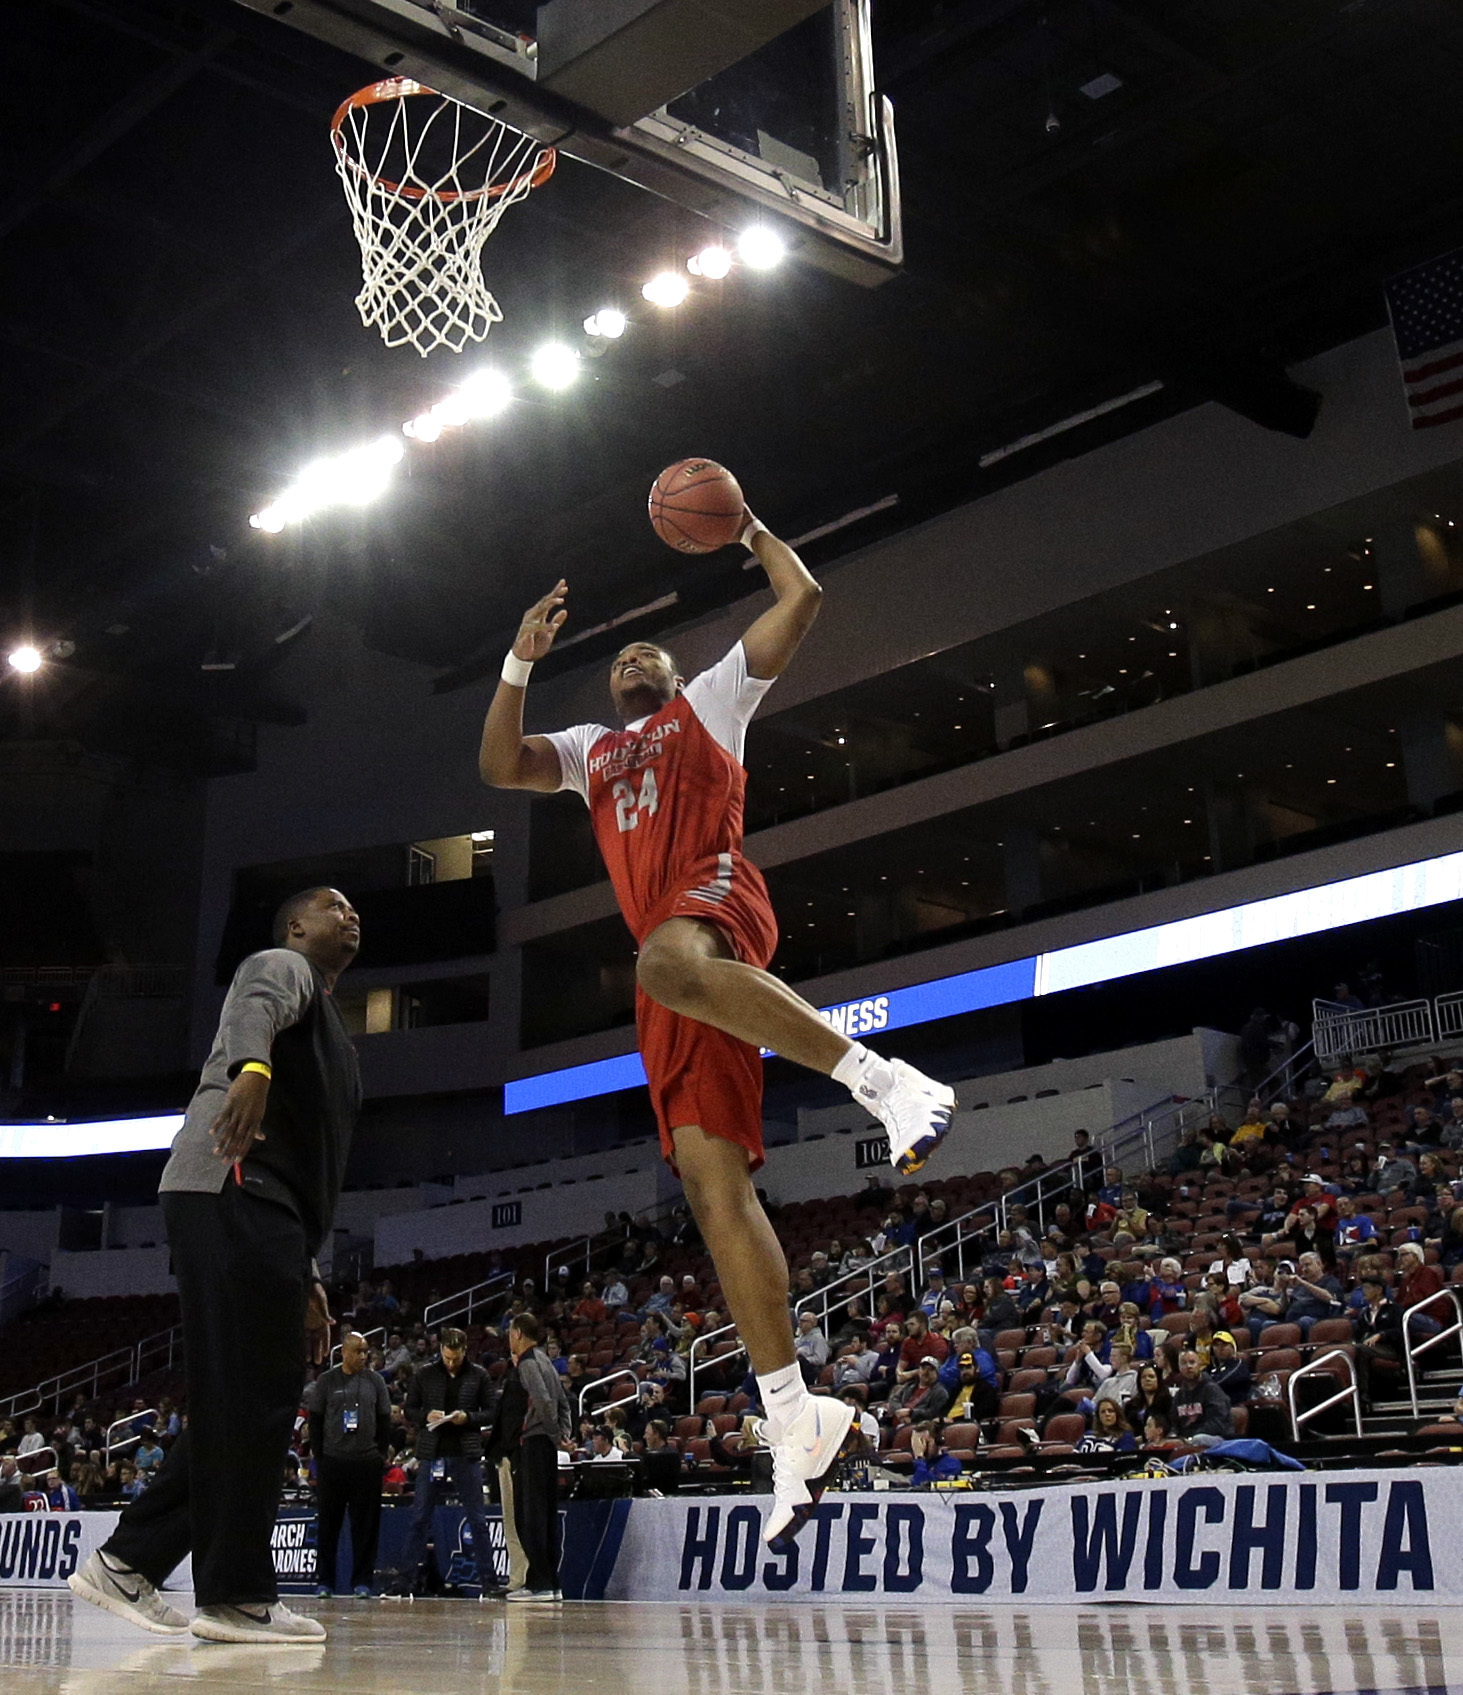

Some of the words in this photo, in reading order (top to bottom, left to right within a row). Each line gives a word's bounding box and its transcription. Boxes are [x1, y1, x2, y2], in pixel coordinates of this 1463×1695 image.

[612, 767, 658, 833] 24
[497, 1204, 517, 1225] 101
[0, 1520, 81, 1579] UNDS
[270, 1523, 306, 1548] ARCH
[678, 1501, 925, 1593] HOSTED
[951, 1498, 1044, 1594] BY
[1071, 1480, 1434, 1592] WICHITA
